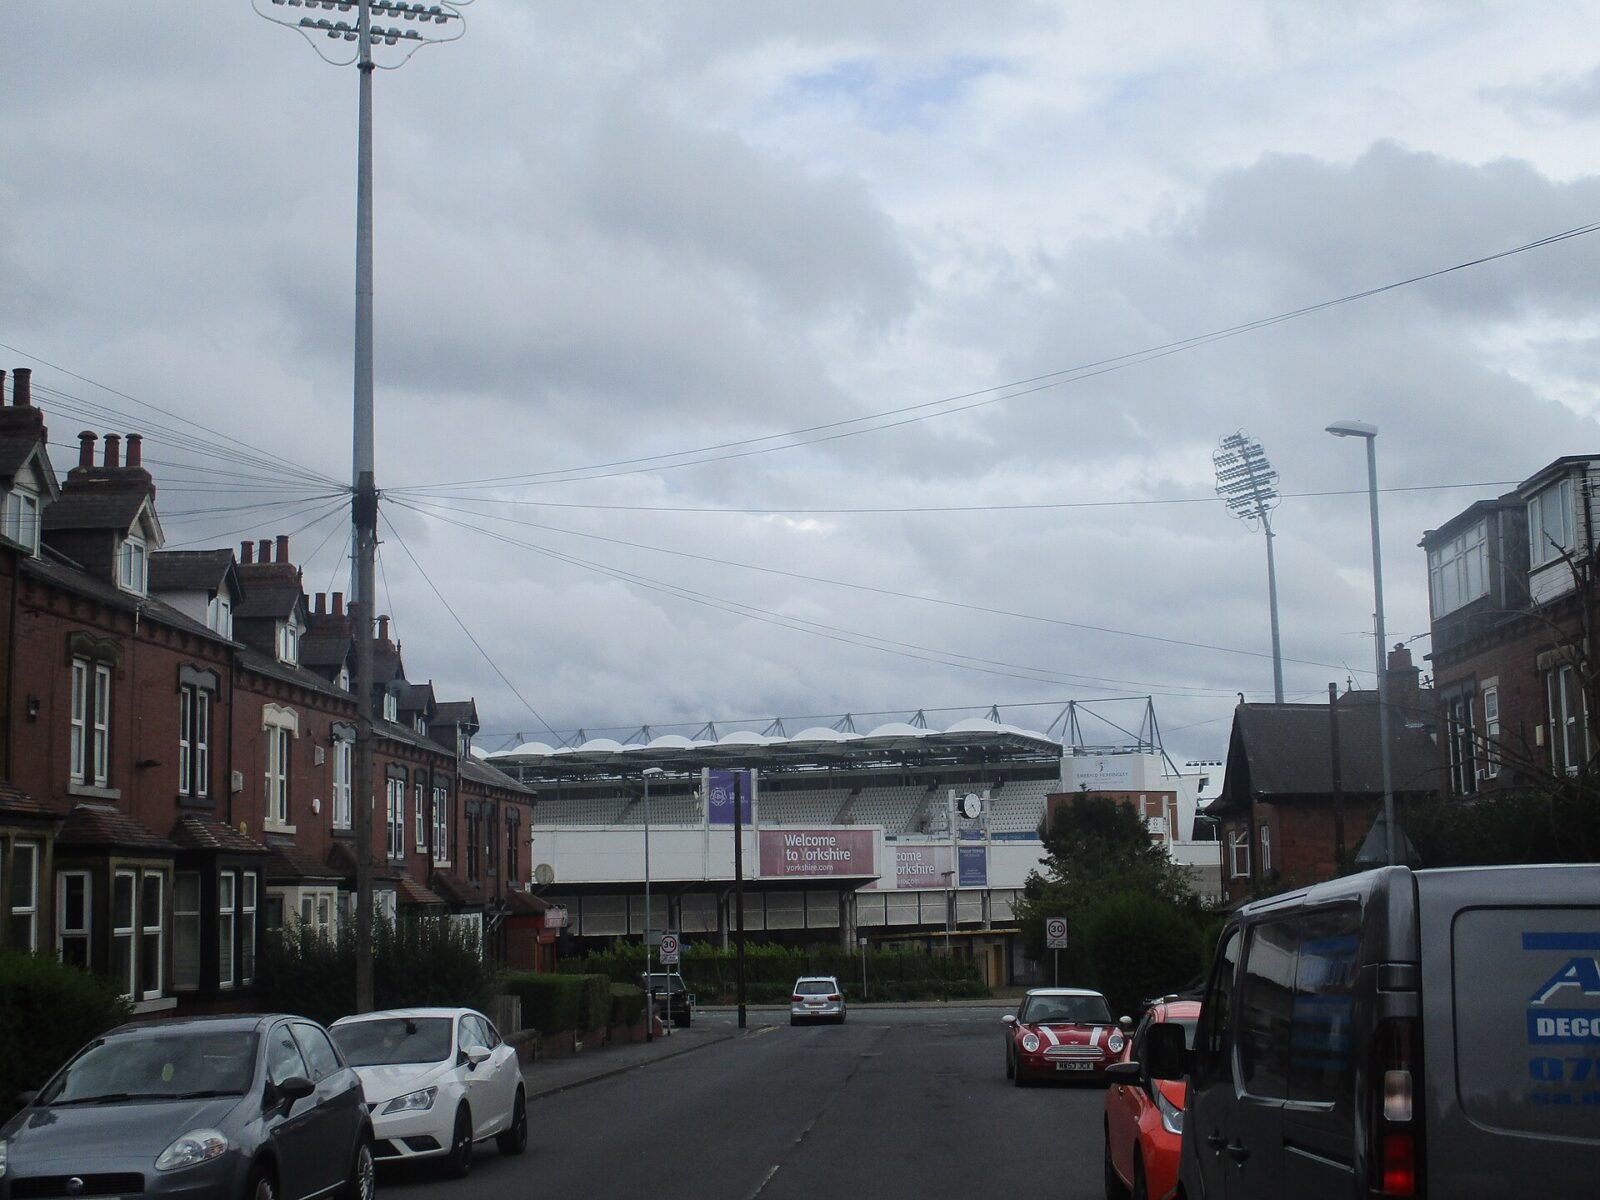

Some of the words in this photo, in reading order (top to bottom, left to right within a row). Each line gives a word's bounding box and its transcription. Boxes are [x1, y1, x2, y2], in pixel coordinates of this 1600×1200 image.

[784, 833, 836, 847] Welcome
[786, 849, 799, 861] to
[800, 847, 851, 861] Yorkshire
[786, 863, 834, 873] yorkshire.com
[897, 861, 935, 875] orkshire
[1050, 925, 1063, 933] 30
[1528, 1056, 1600, 1081] 07
